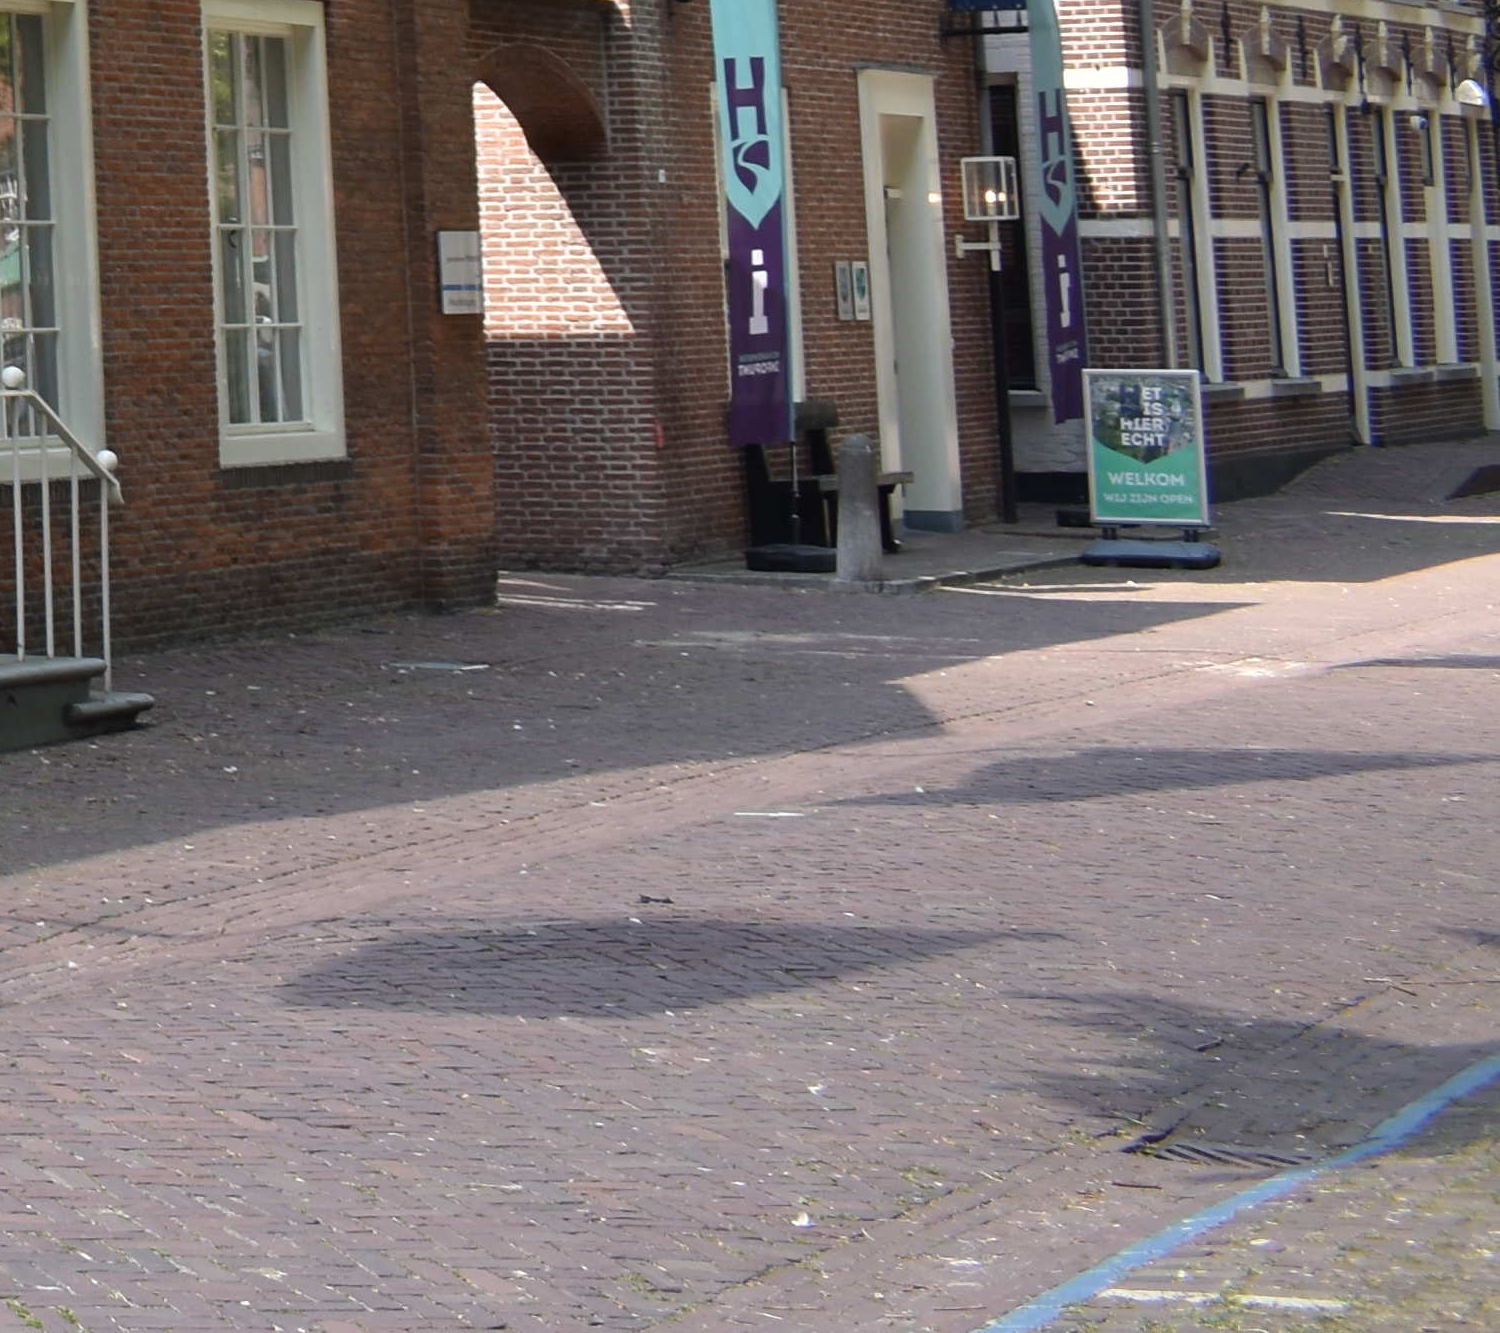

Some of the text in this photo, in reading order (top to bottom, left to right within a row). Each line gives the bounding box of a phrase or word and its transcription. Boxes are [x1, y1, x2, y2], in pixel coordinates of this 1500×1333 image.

[1143, 402, 1163, 416] IS
[1120, 417, 1164, 431] HIER
[1121, 432, 1165, 446] ECHT
[1107, 471, 1185, 486] WELKOM
[1103, 493, 1193, 504] WIJ ZIJN OPEN
